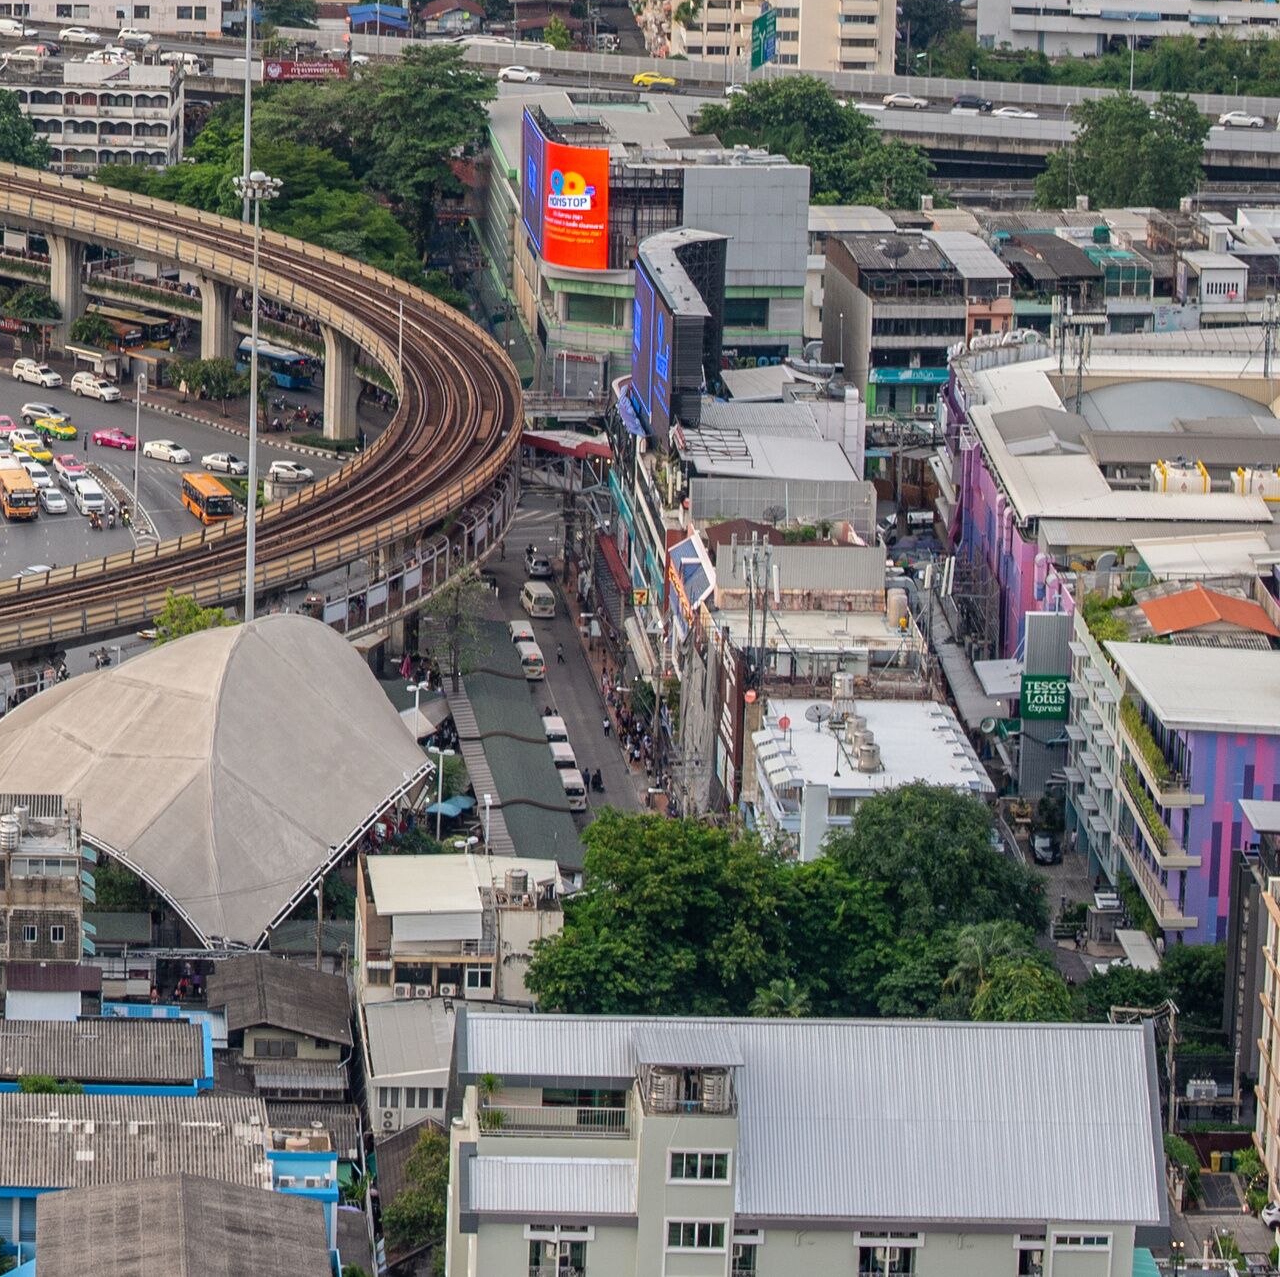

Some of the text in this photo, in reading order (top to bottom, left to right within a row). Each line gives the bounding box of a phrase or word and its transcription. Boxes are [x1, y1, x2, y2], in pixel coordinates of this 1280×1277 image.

[1025, 681, 1066, 691] TESCO
[1026, 691, 1066, 704] Lotus
[1028, 704, 1062, 714] express
